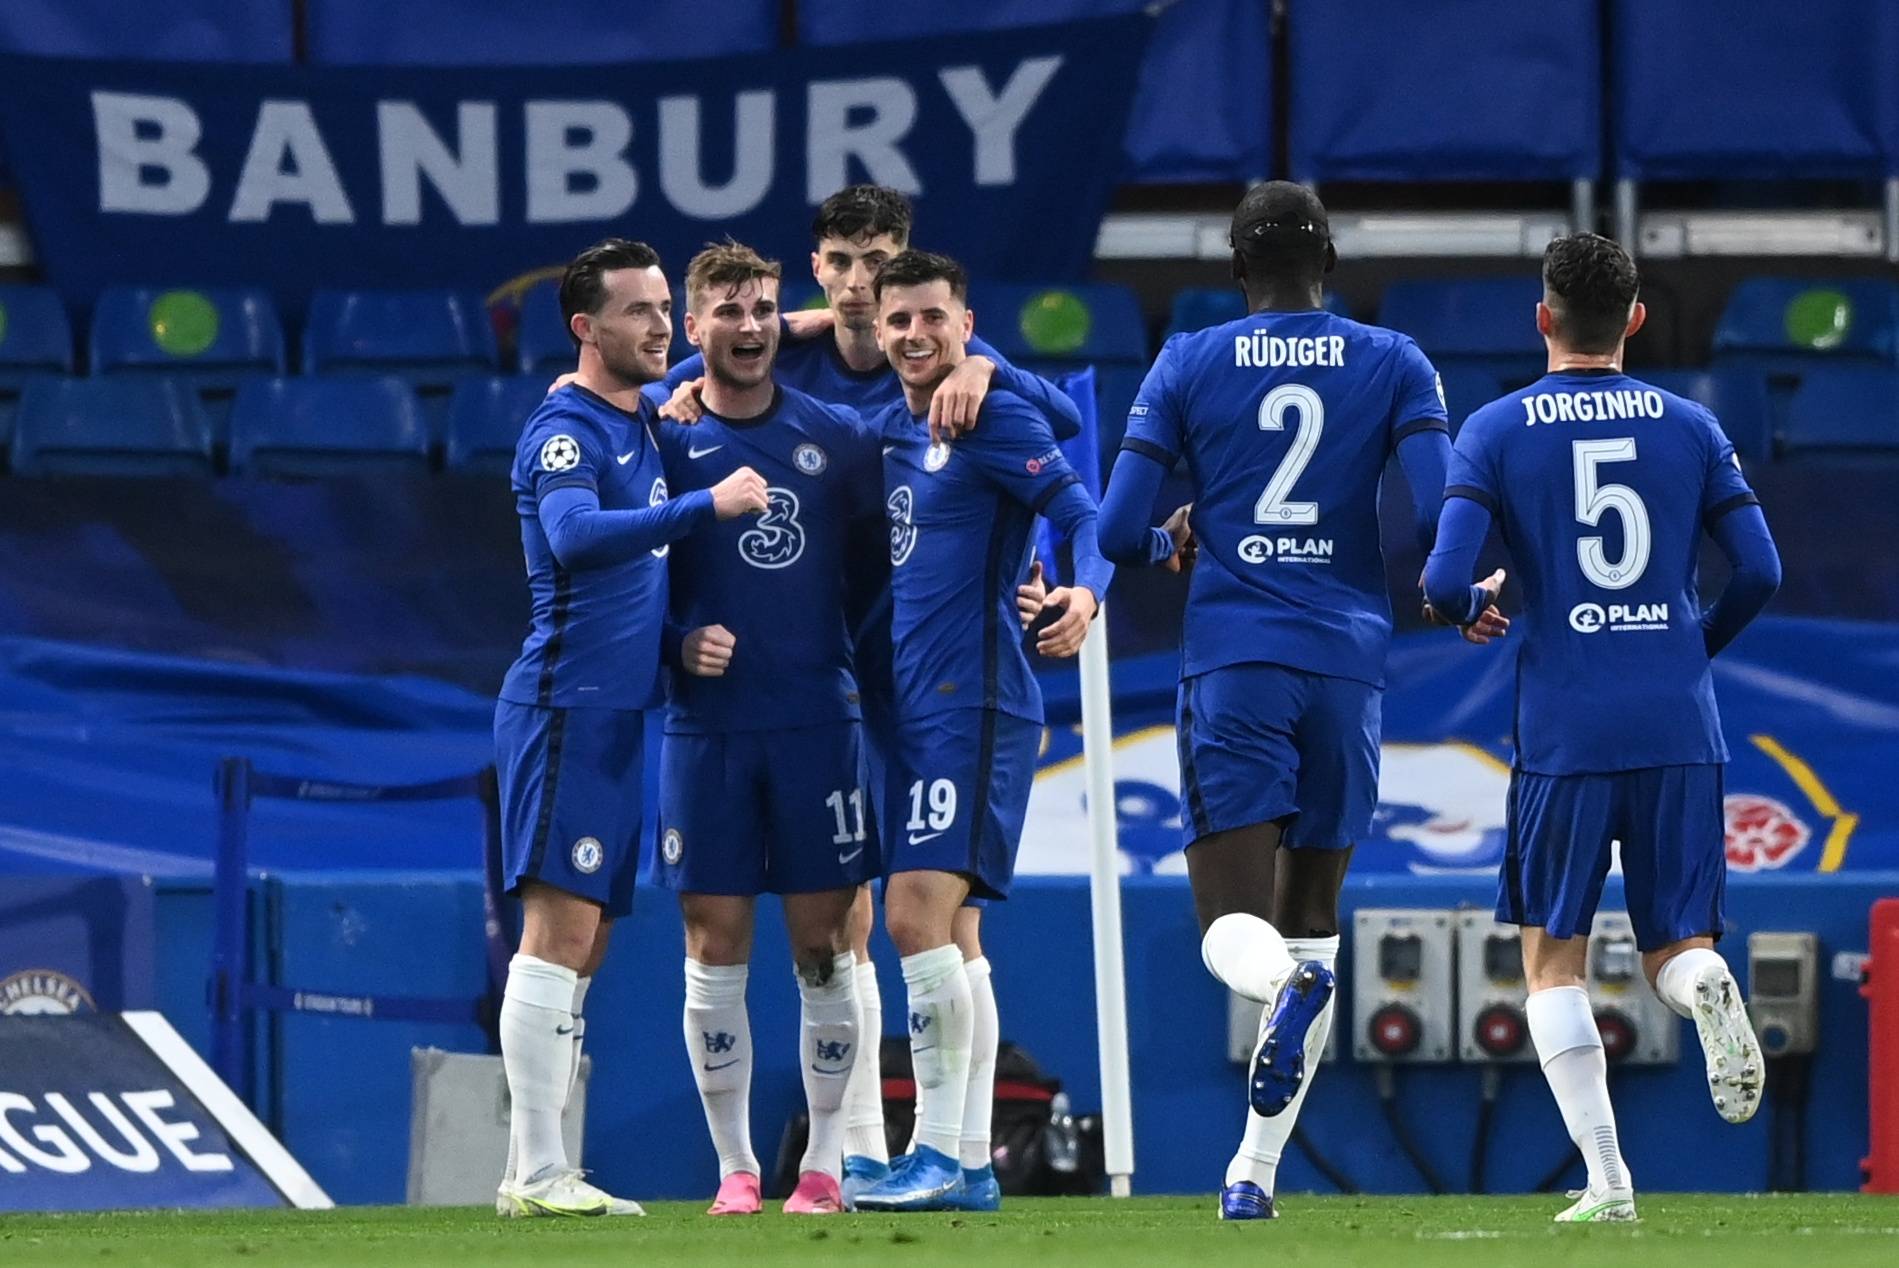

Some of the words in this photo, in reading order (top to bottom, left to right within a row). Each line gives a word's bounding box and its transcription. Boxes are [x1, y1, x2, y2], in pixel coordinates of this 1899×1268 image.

[91, 55, 1066, 225] BANBURY
[1235, 328, 1345, 367] RÜDIGER
[1521, 390, 1664, 427] JORGINHO
[1254, 383, 1324, 525] 2
[738, 487, 806, 569] 3
[1572, 437, 1651, 590] 5
[1277, 537, 1333, 555] PLAN
[1608, 603, 1668, 622] PLAN
[825, 788, 867, 845] 11
[906, 778, 957, 831] 19
[0, 1089, 235, 1173] GUE
